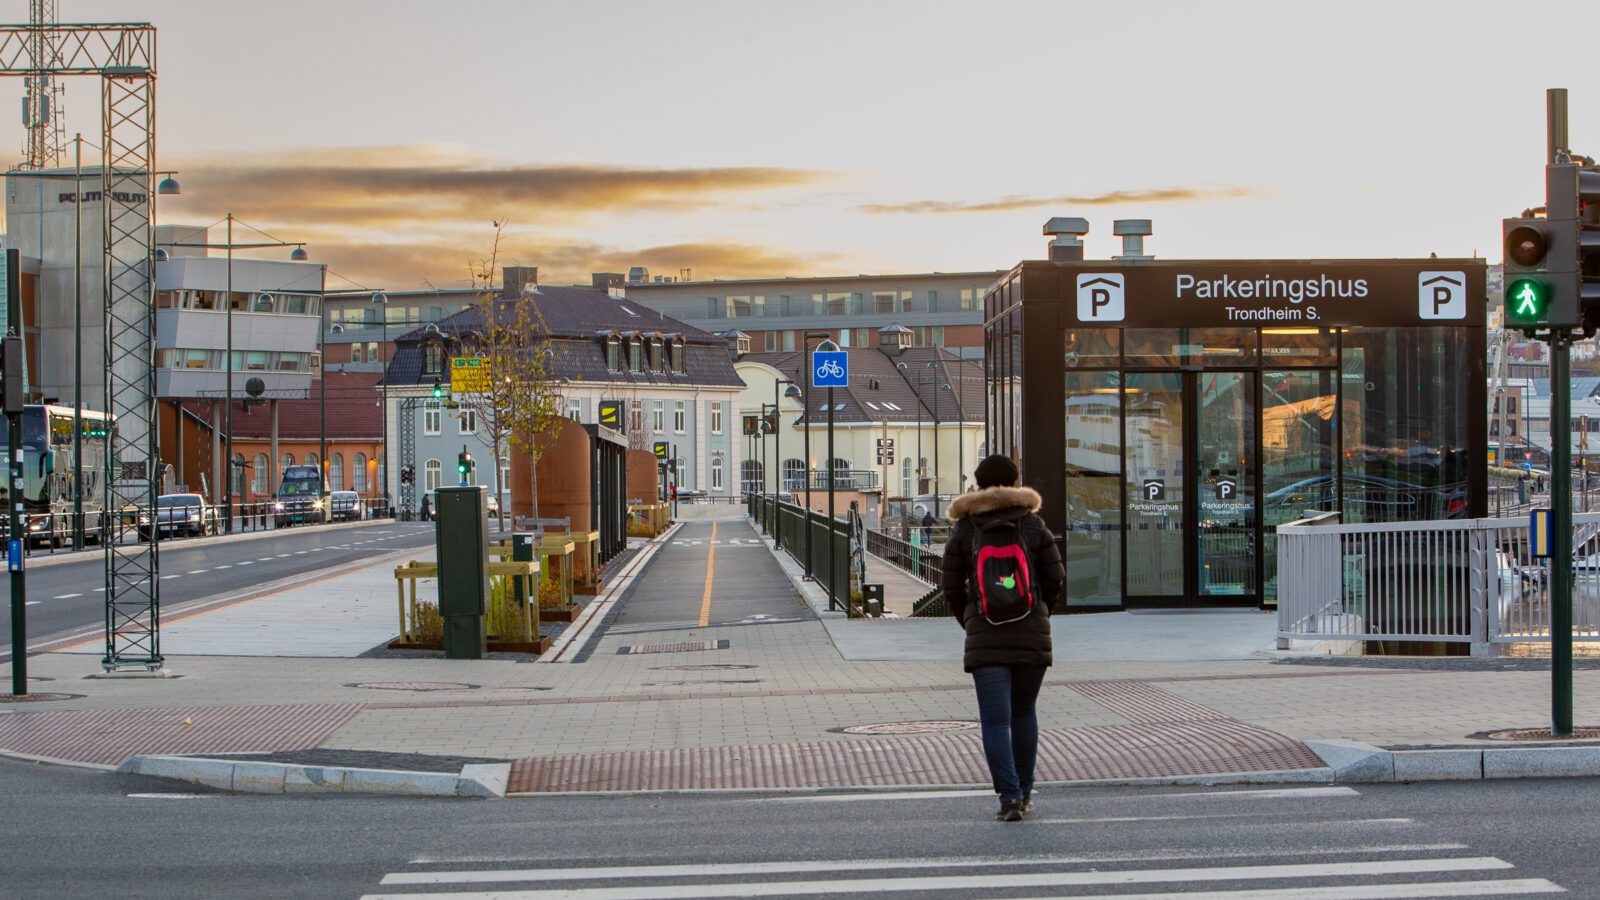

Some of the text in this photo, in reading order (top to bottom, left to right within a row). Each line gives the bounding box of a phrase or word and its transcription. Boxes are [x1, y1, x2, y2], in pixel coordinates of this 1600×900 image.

[1176, 274, 1369, 303] Parkeringshus
[1092, 289, 1110, 317] P
[1433, 287, 1451, 315] P
[1225, 306, 1321, 320] Trondheim S.
[1149, 486, 1159, 500] P
[1221, 485, 1231, 499] P
[1129, 503, 1179, 512] Parkeringshus
[1201, 502, 1251, 511] Parkeringshus
